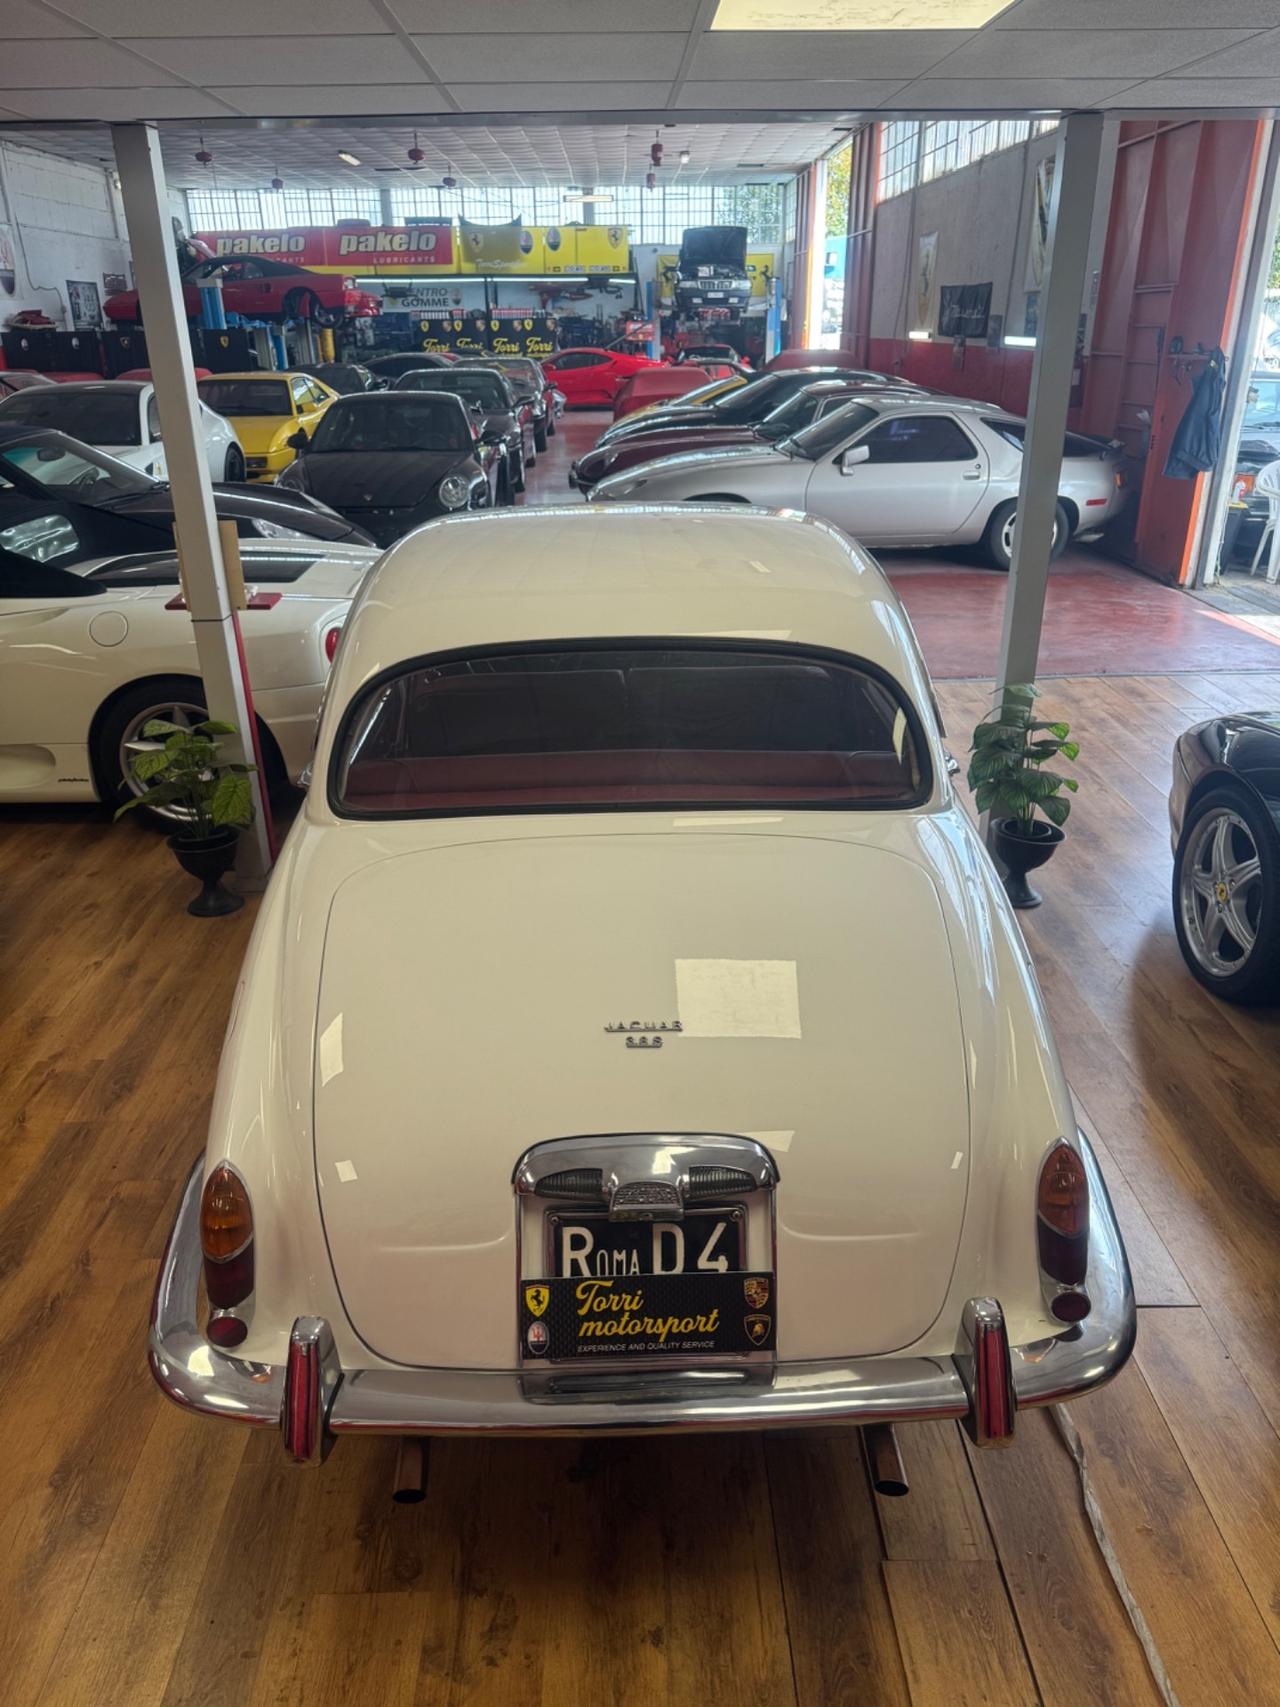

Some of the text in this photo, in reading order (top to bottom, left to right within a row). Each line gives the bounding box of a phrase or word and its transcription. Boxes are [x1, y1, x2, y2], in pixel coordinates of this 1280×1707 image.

[216, 233, 306, 257] pakelo
[339, 231, 437, 255] pakelo
[373, 256, 435, 264] LUBRICANTS
[401, 297, 449, 308] GOMME
[492, 338, 520, 353] Torri
[526, 337, 553, 353] Torri
[604, 1020, 683, 1033] JAGUAR
[653, 1222, 685, 1275] D
[697, 1221, 729, 1273] 4
[576, 1280, 644, 1316] Torri
[578, 1308, 720, 1343] motorsport
[577, 1340, 715, 1353] EXPERIENCE AND QUALITY SERVICE
